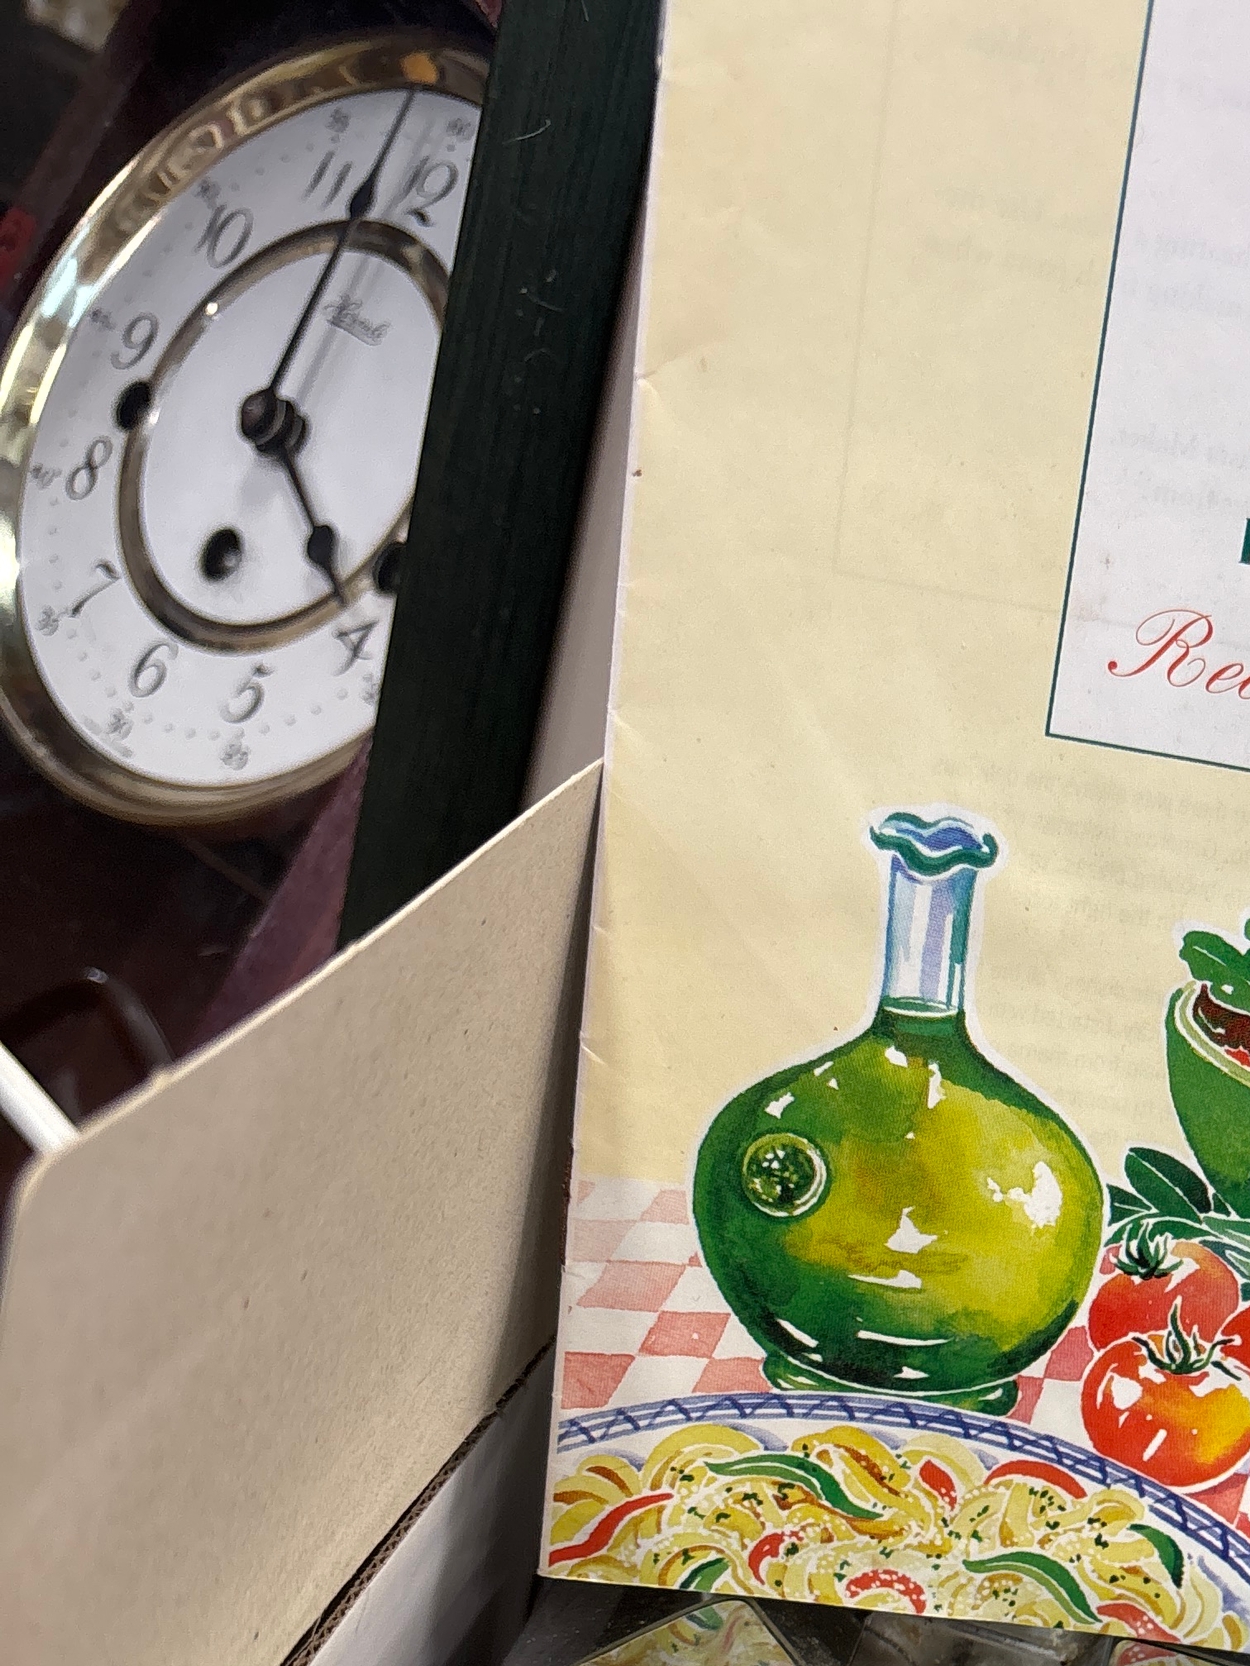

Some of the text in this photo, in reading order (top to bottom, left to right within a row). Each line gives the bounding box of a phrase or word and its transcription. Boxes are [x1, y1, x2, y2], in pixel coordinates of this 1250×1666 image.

[303, 151, 352, 212] 11
[398, 155, 460, 228] 12
[199, 202, 255, 270] 10
[109, 312, 160, 372] 9
[64, 435, 113, 502] 8
[67, 560, 122, 622] 7
[128, 641, 179, 700] 6
[334, 620, 379, 676] 4
[218, 665, 275, 725] 5
